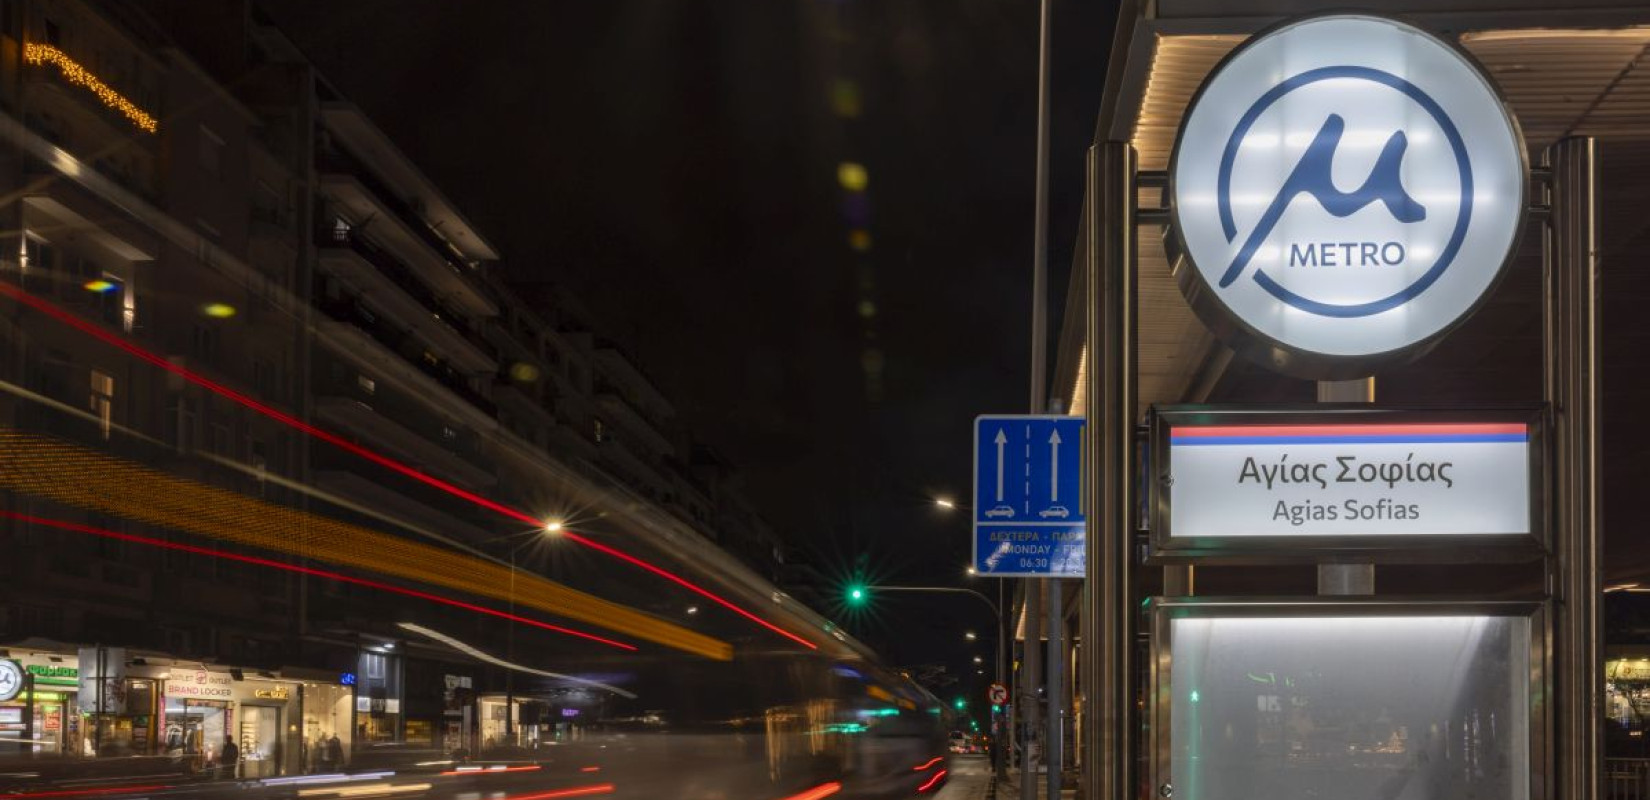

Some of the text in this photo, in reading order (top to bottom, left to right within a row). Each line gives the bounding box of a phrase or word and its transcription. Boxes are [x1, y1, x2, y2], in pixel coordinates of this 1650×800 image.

[1290, 242, 1406, 267] METRO
[1238, 453, 1453, 490] Αγίας Σοφίας
[1273, 498, 1420, 526] Agias Sofias
[168, 685, 232, 696] BRAND LOCKER
